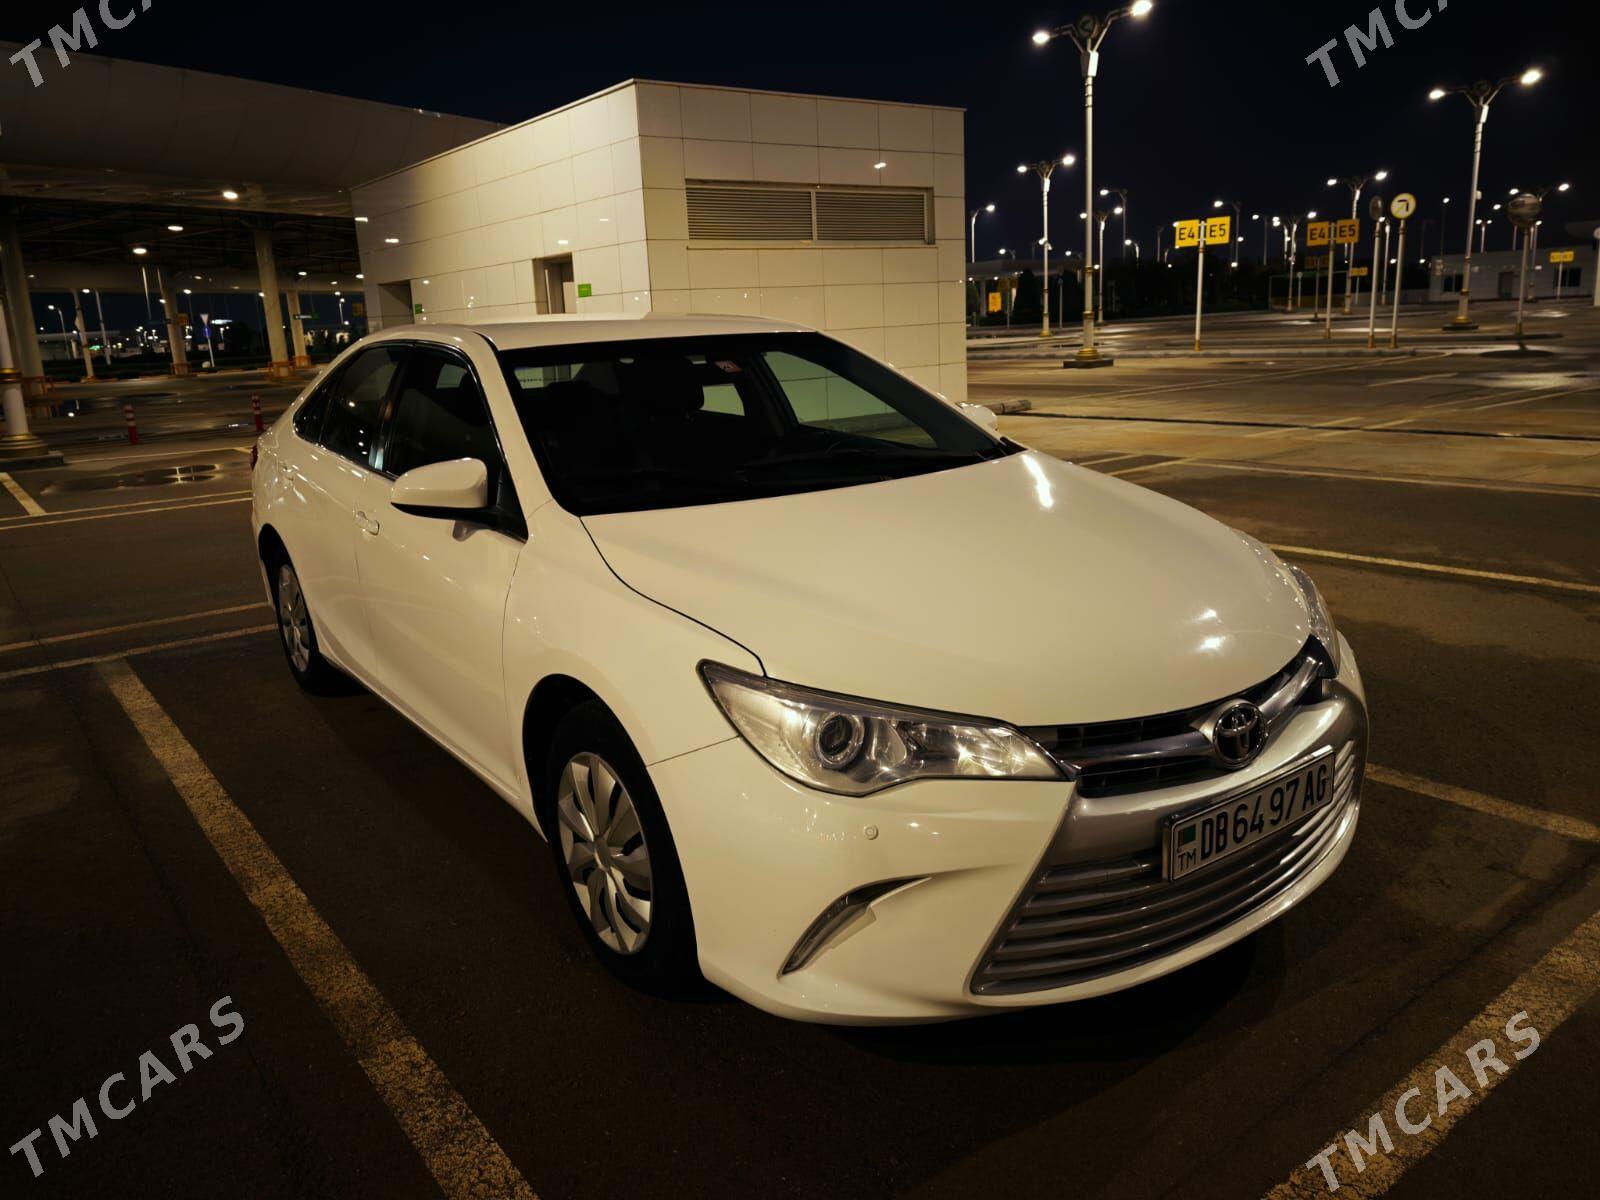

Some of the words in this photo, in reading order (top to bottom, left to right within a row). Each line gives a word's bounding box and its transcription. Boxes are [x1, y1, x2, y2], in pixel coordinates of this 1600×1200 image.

[1178, 226, 1195, 241] E4
[1209, 223, 1226, 238] E5
[1309, 227, 1326, 241] E4
[1339, 224, 1356, 238] E5
[1178, 849, 1196, 871] TM
